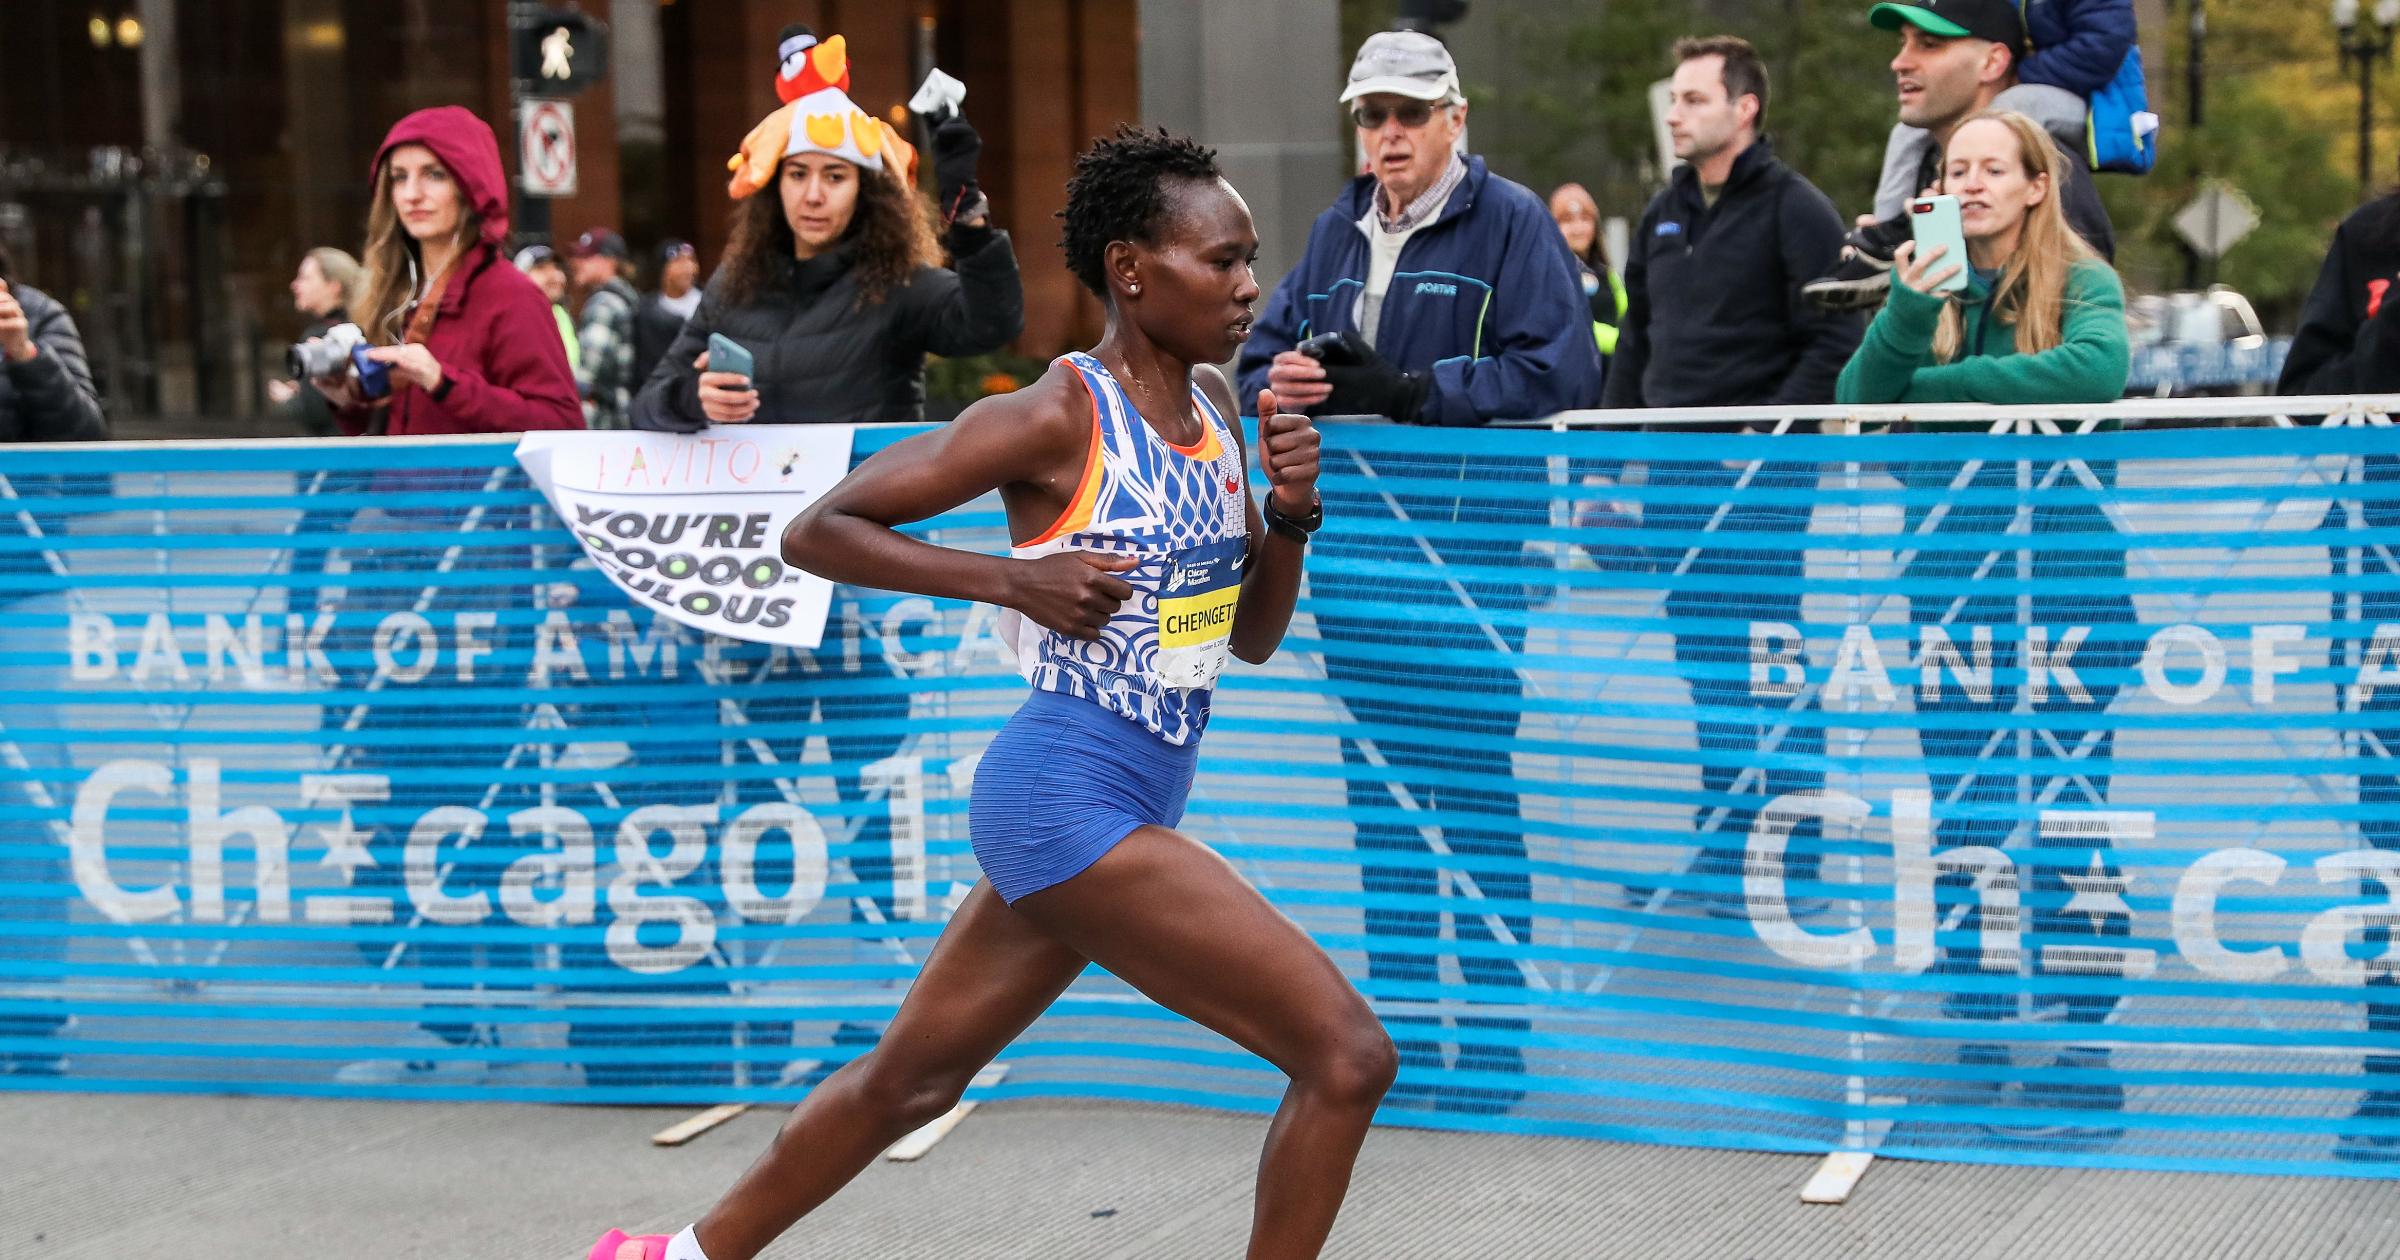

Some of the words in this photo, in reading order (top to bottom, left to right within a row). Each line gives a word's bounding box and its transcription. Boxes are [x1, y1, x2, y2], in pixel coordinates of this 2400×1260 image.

[575, 503, 771, 549] YOU'RE
[69, 611, 341, 682] BANK
[373, 610, 498, 683] OF
[1748, 619, 2096, 703] BANK
[2141, 622, 2308, 705] OF
